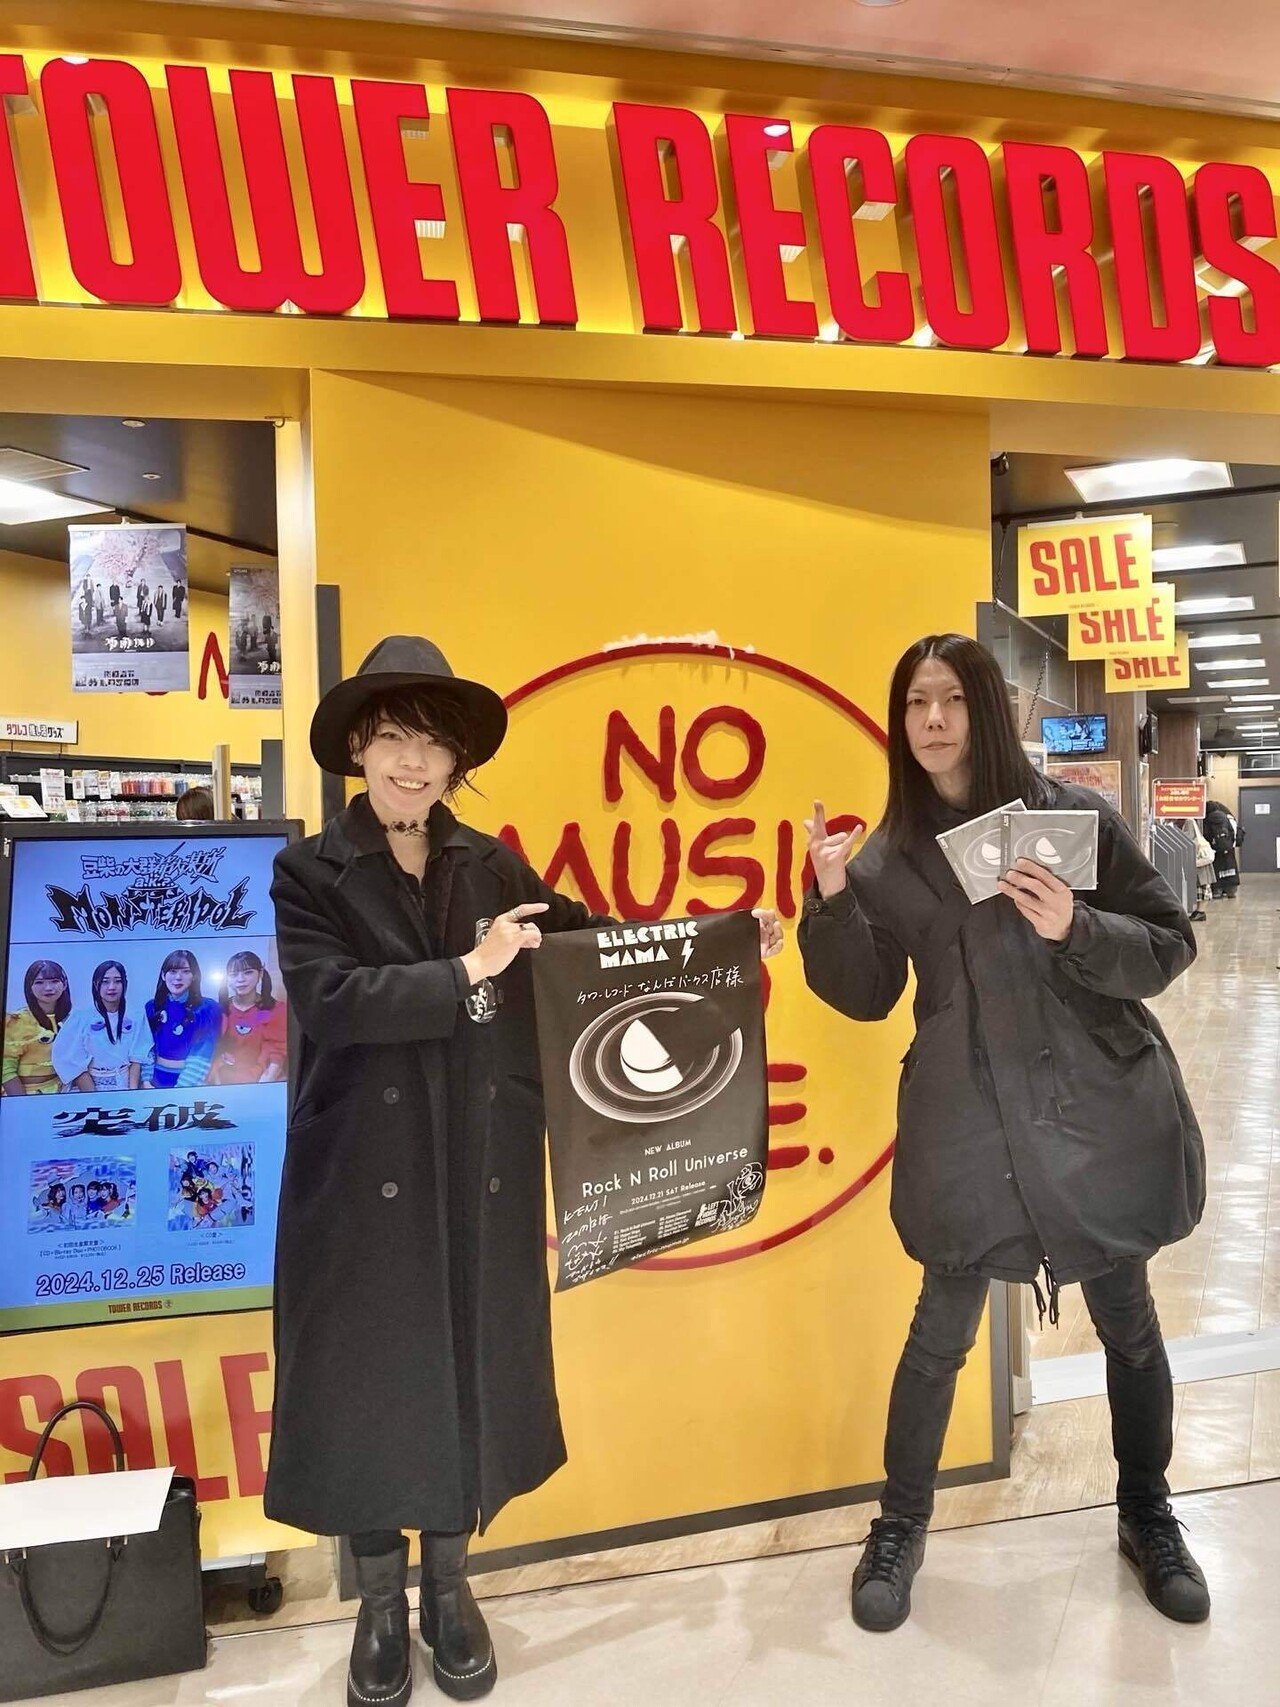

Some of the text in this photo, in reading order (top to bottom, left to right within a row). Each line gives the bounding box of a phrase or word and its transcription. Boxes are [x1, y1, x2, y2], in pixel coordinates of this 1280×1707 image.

[613, 102, 1280, 367] RECORDS
[1030, 533, 1139, 596] SALE
[603, 705, 767, 803] NO
[596, 920, 699, 949] ELECTRIC
[599, 944, 670, 969] MAMA
[52, 1101, 239, 1139] 突破
[644, 1139, 692, 1156] NEW ALBUM
[582, 1147, 748, 1198] Rock N Roll Universe
[680, 1181, 706, 1191] Release
[36, 1262, 246, 1297] 2024.12.25 Release
[108, 1300, 163, 1314] TOWER RECORDS
[0, 1352, 271, 1502] SALE
